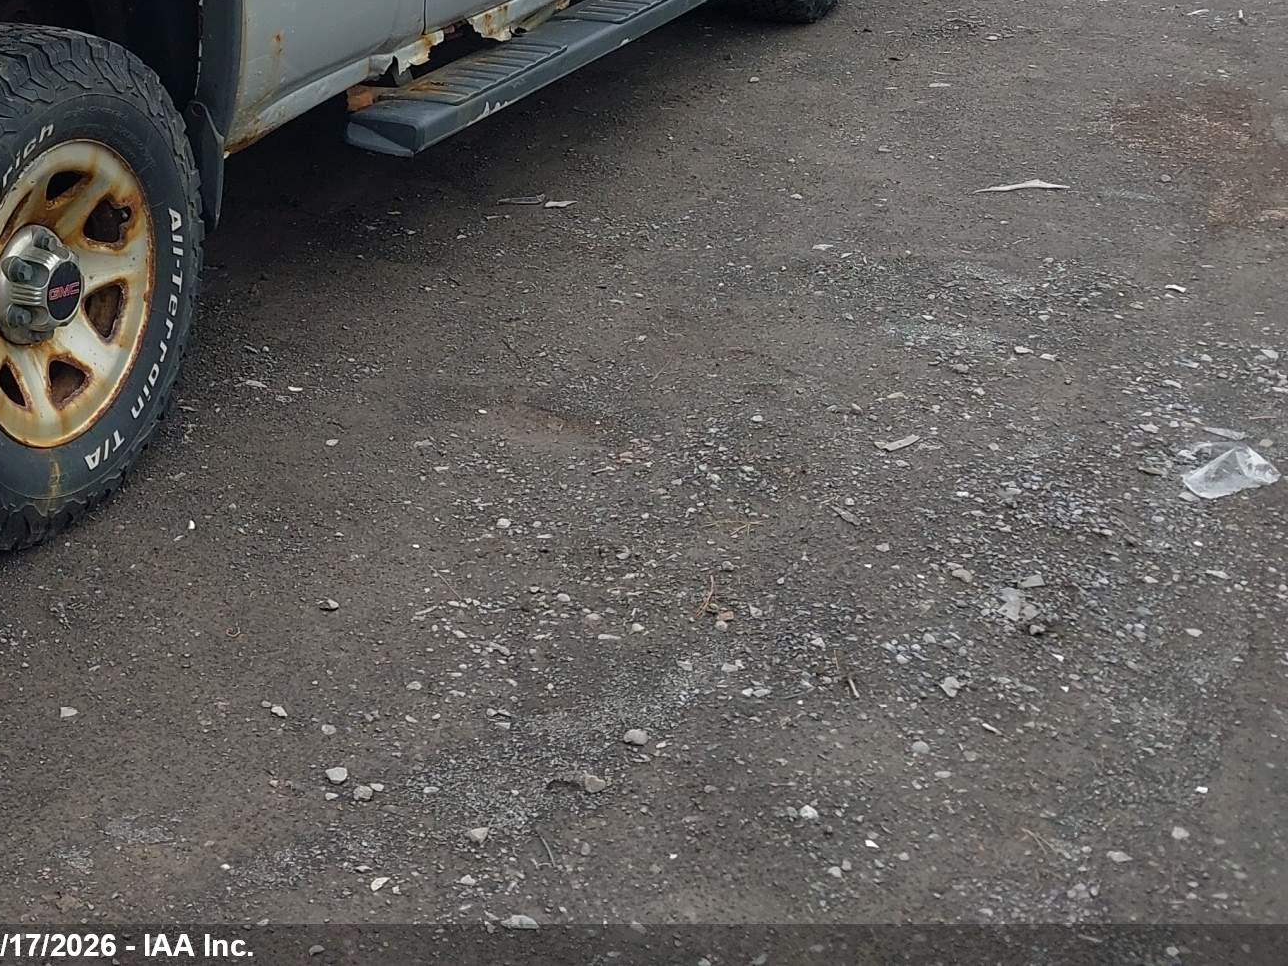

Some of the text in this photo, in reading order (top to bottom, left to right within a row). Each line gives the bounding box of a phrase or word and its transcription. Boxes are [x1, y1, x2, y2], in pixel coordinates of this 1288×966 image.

[48, 281, 81, 301] GMC
[130, 206, 185, 420] All-Terrain
[83, 428, 126, 472] T/A
